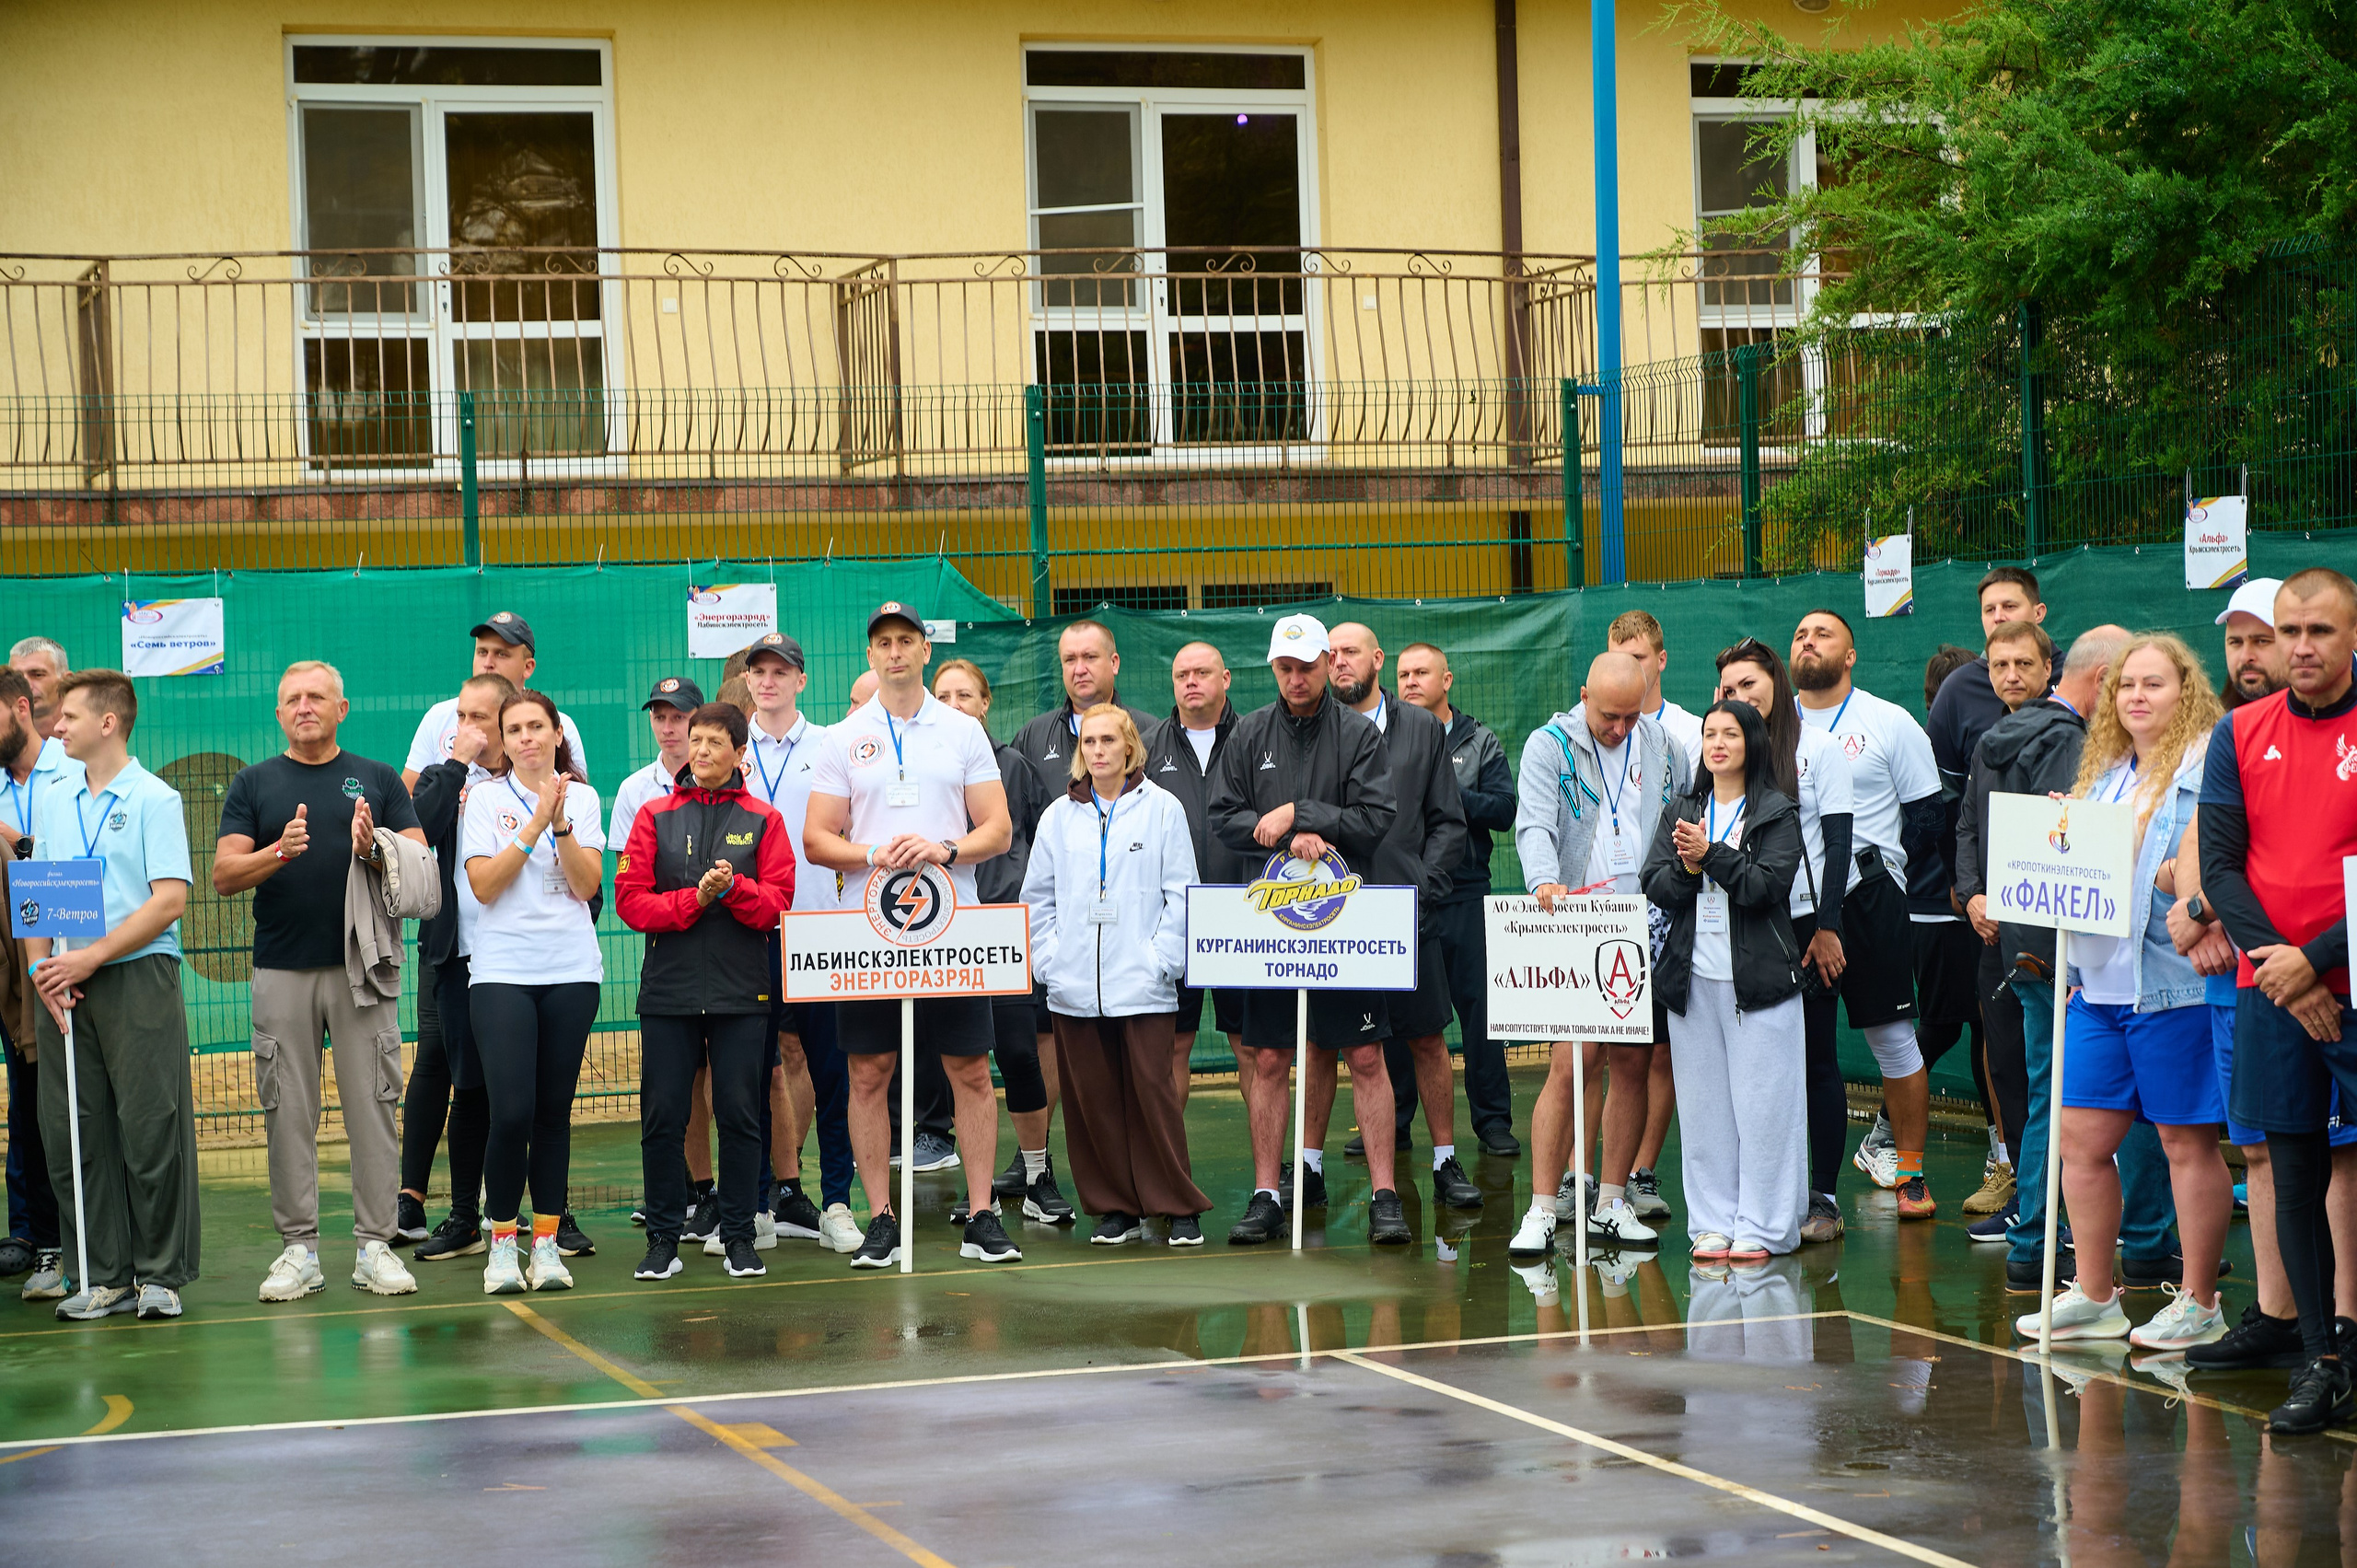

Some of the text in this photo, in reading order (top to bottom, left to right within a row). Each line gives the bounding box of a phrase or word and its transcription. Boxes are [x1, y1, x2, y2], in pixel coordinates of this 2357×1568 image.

[694, 612, 771, 623] «Энергоразряд»
[130, 639, 216, 651] «Семь ветров»
[2007, 859, 2111, 880] «КРОПОТКИНЭЛЕКТРОСЕТЬ»
[12, 878, 99, 889] «Новороссийскэлектросеть»
[1492, 900, 1509, 913] АО
[1590, 899, 1639, 916] Кубани»
[2001, 878, 2116, 921] «ФАКЕЛ»
[47, 907, 99, 923] 7-Ветров
[1504, 921, 1628, 937] «Крымскэлектросеть»
[1196, 938, 1407, 955] КУРГАНИНСКЭЛЕКТРОСЕТЬ
[790, 946, 1024, 971] ЛАБИНСКЭЛЕКТРОСЕТЬ
[830, 968, 985, 992] ЭНЕРГОРАЗРЯД
[1264, 962, 1339, 981] ТОРНАДО
[1493, 966, 1591, 990] «АЛЬФА»
[1490, 1023, 1650, 1036] НАМ СОПУТСТВУЕТ УДАЧА ТОЛЬКО ТАК А НЕ ИНАЧЕ!
